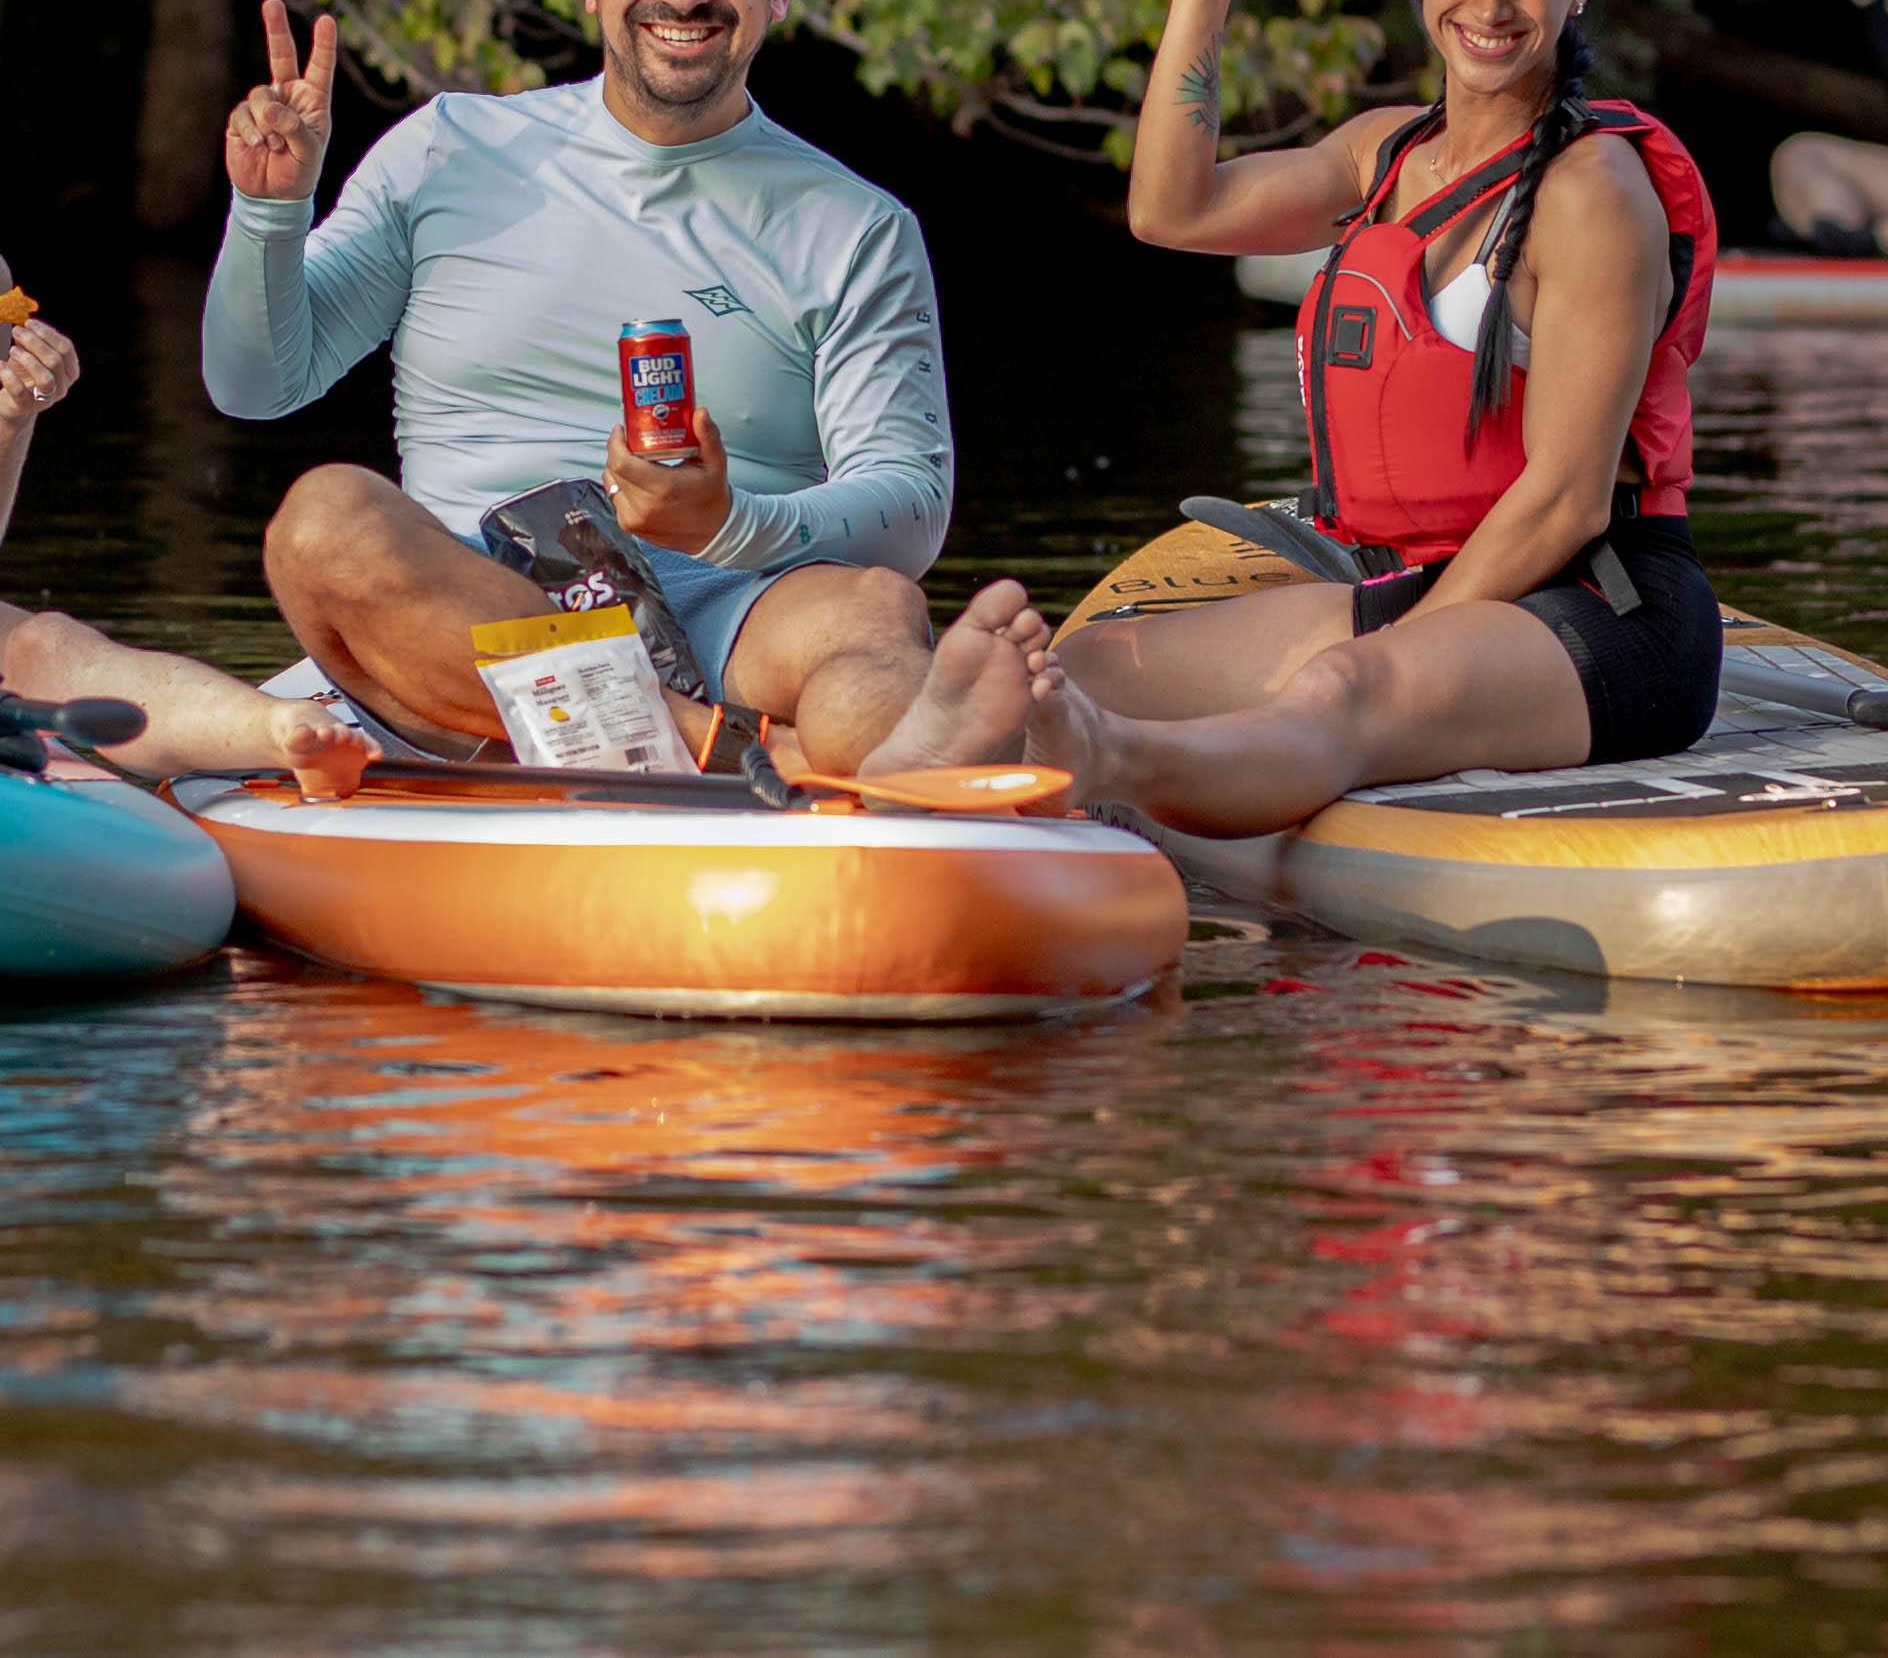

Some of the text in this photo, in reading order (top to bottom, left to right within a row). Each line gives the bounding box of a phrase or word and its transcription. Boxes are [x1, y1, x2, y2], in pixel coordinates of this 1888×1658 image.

[637, 357, 676, 373] BUD
[633, 370, 683, 387] LIGHT
[1109, 573, 1291, 594] Blue
